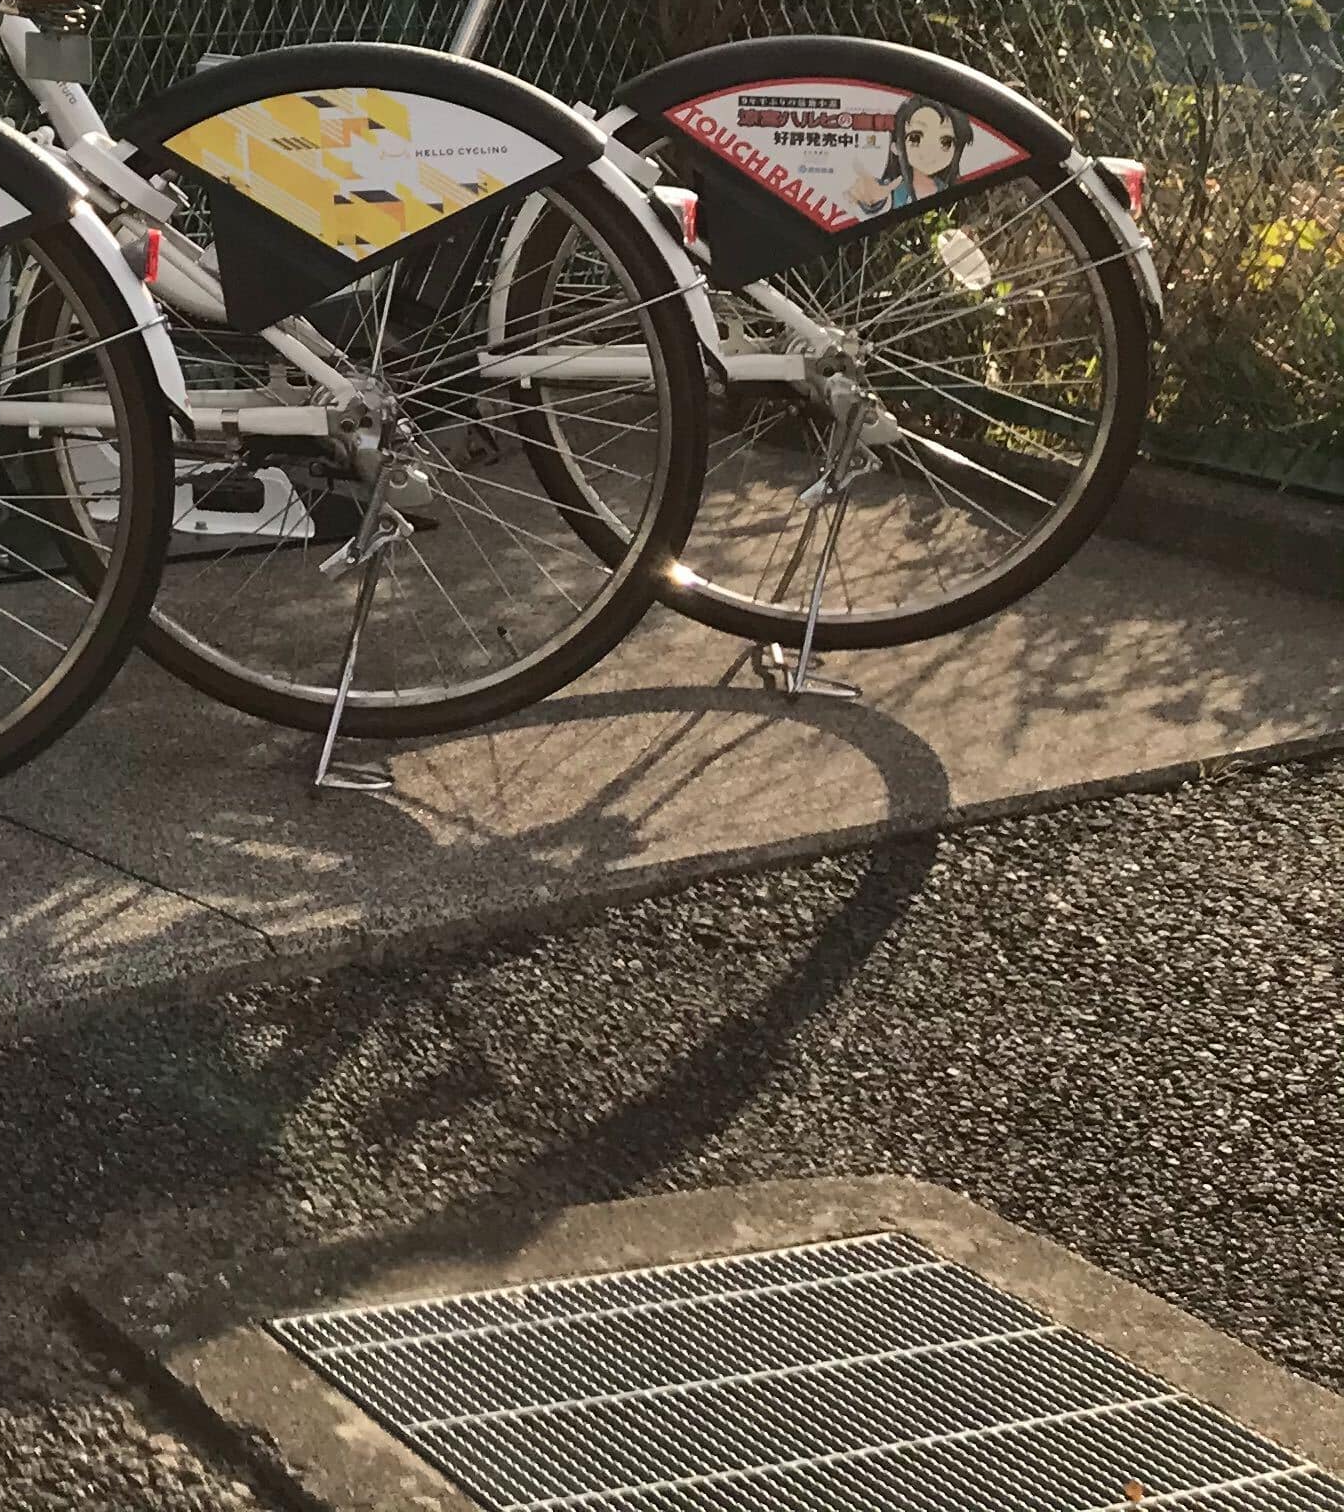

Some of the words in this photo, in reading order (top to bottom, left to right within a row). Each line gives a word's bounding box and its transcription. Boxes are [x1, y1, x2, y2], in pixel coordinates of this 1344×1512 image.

[415, 149, 454, 157] HELLO
[458, 145, 508, 155] CYCLING
[684, 105, 770, 176] TOUCH
[767, 164, 846, 225] RALLY
